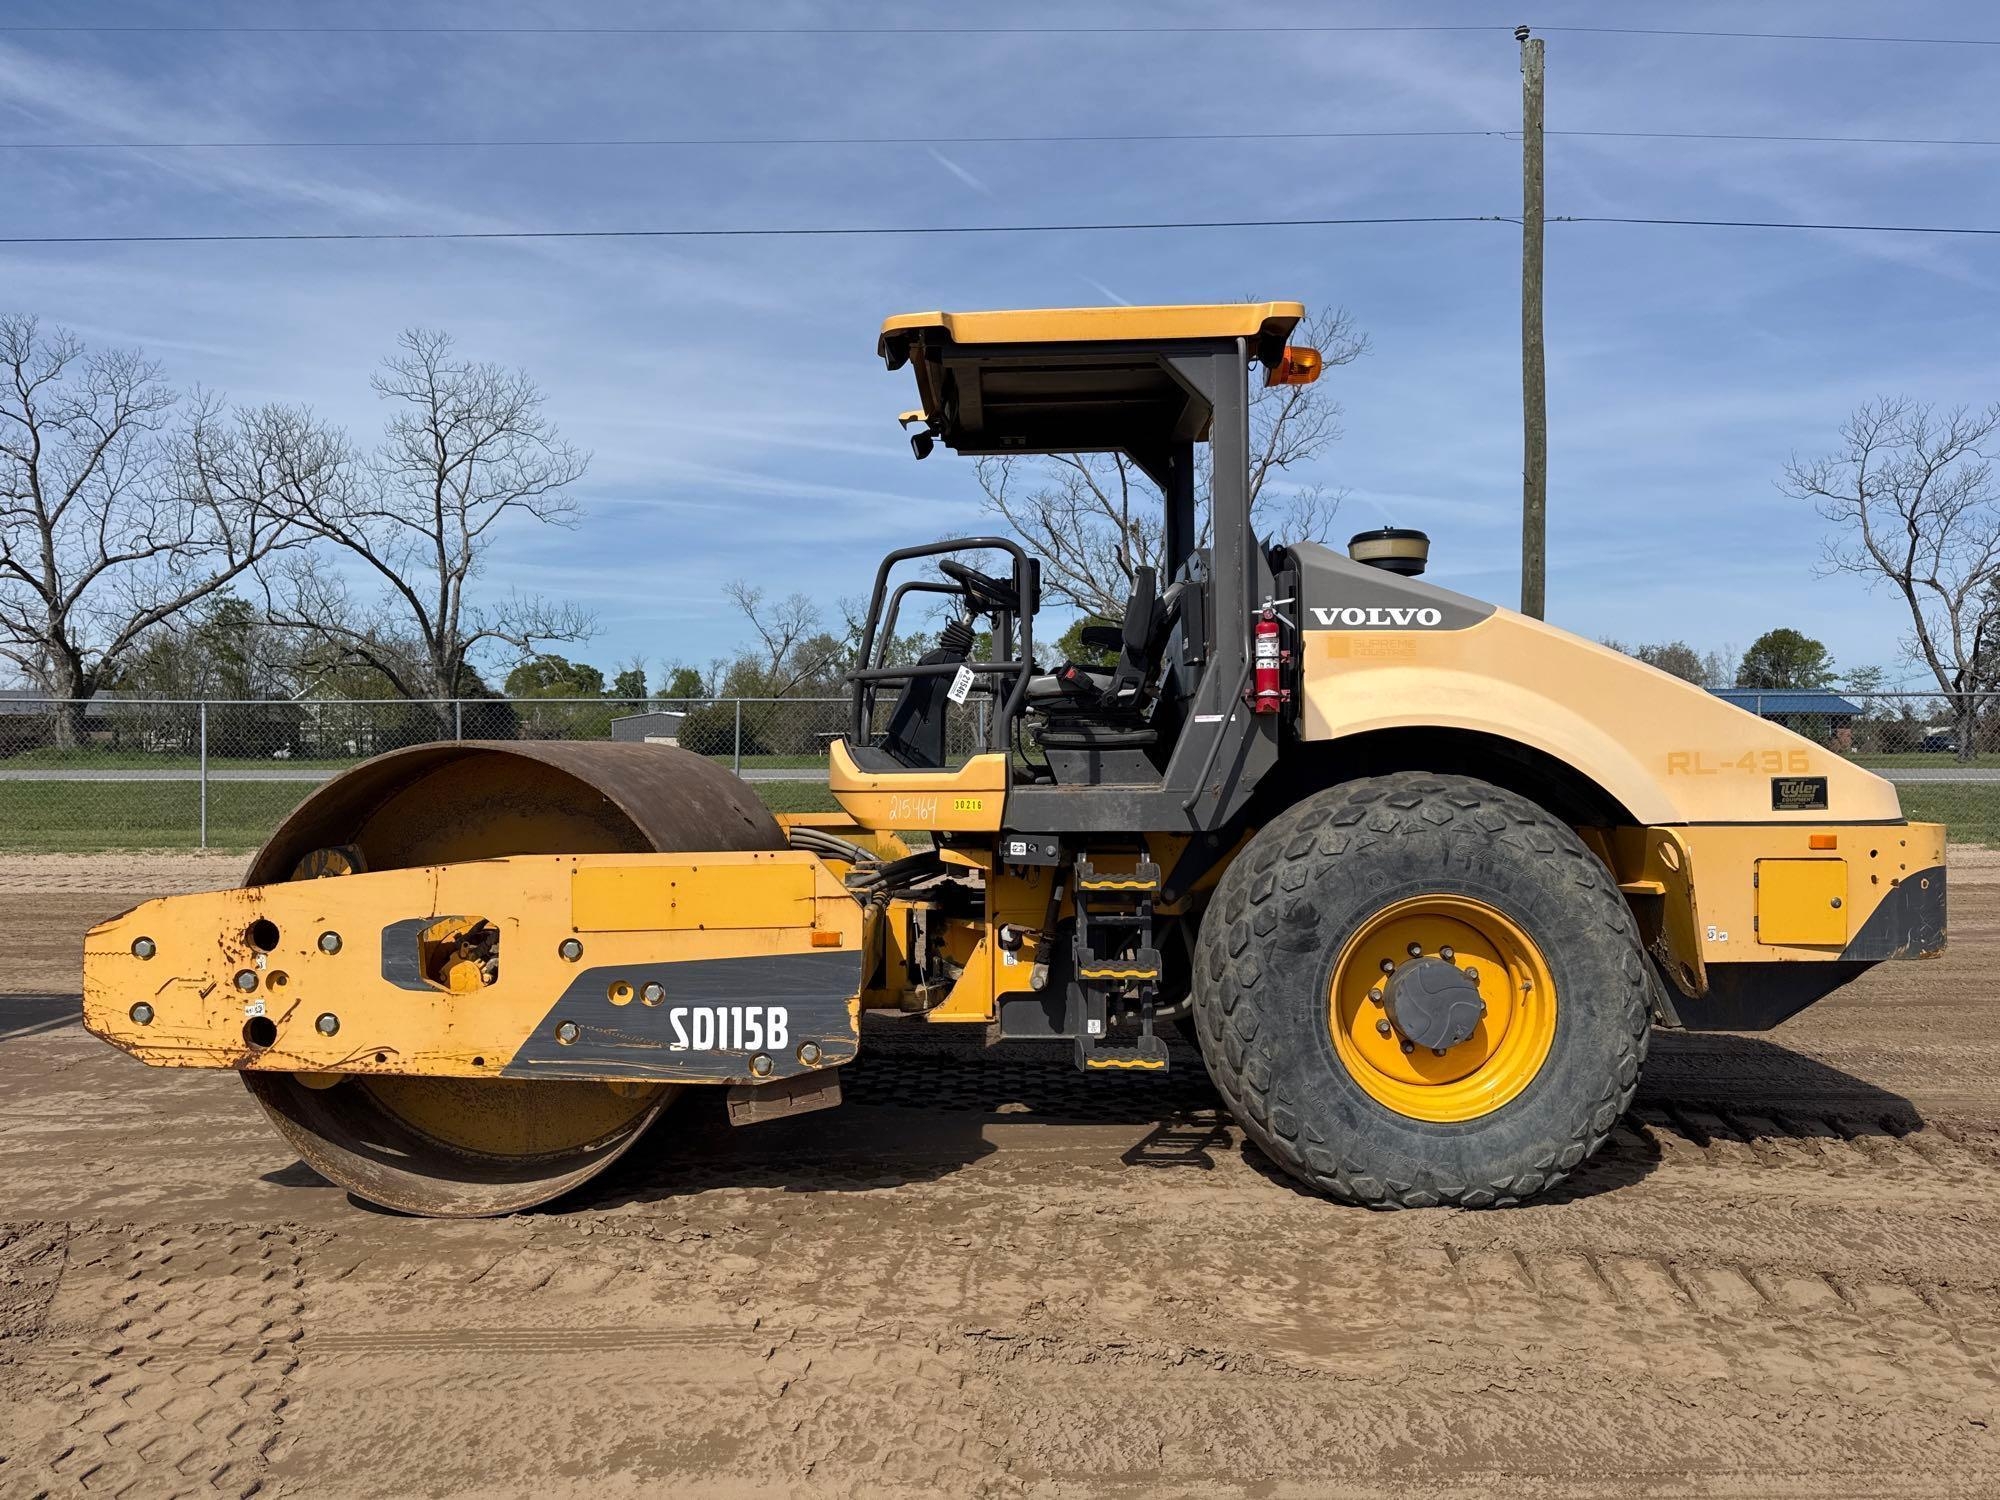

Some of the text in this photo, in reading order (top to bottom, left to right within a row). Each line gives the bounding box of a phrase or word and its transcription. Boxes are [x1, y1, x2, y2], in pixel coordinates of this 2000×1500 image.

[1310, 607, 1442, 626] VOLVO
[1353, 639, 1416, 648] SUPREME
[954, 674, 971, 699] 215464
[1667, 750, 1810, 775] RL-436
[1779, 781, 1820, 798] Tyler
[889, 795, 938, 824] 215464
[955, 800, 982, 810] 30216
[669, 1006, 789, 1051] SD115B
